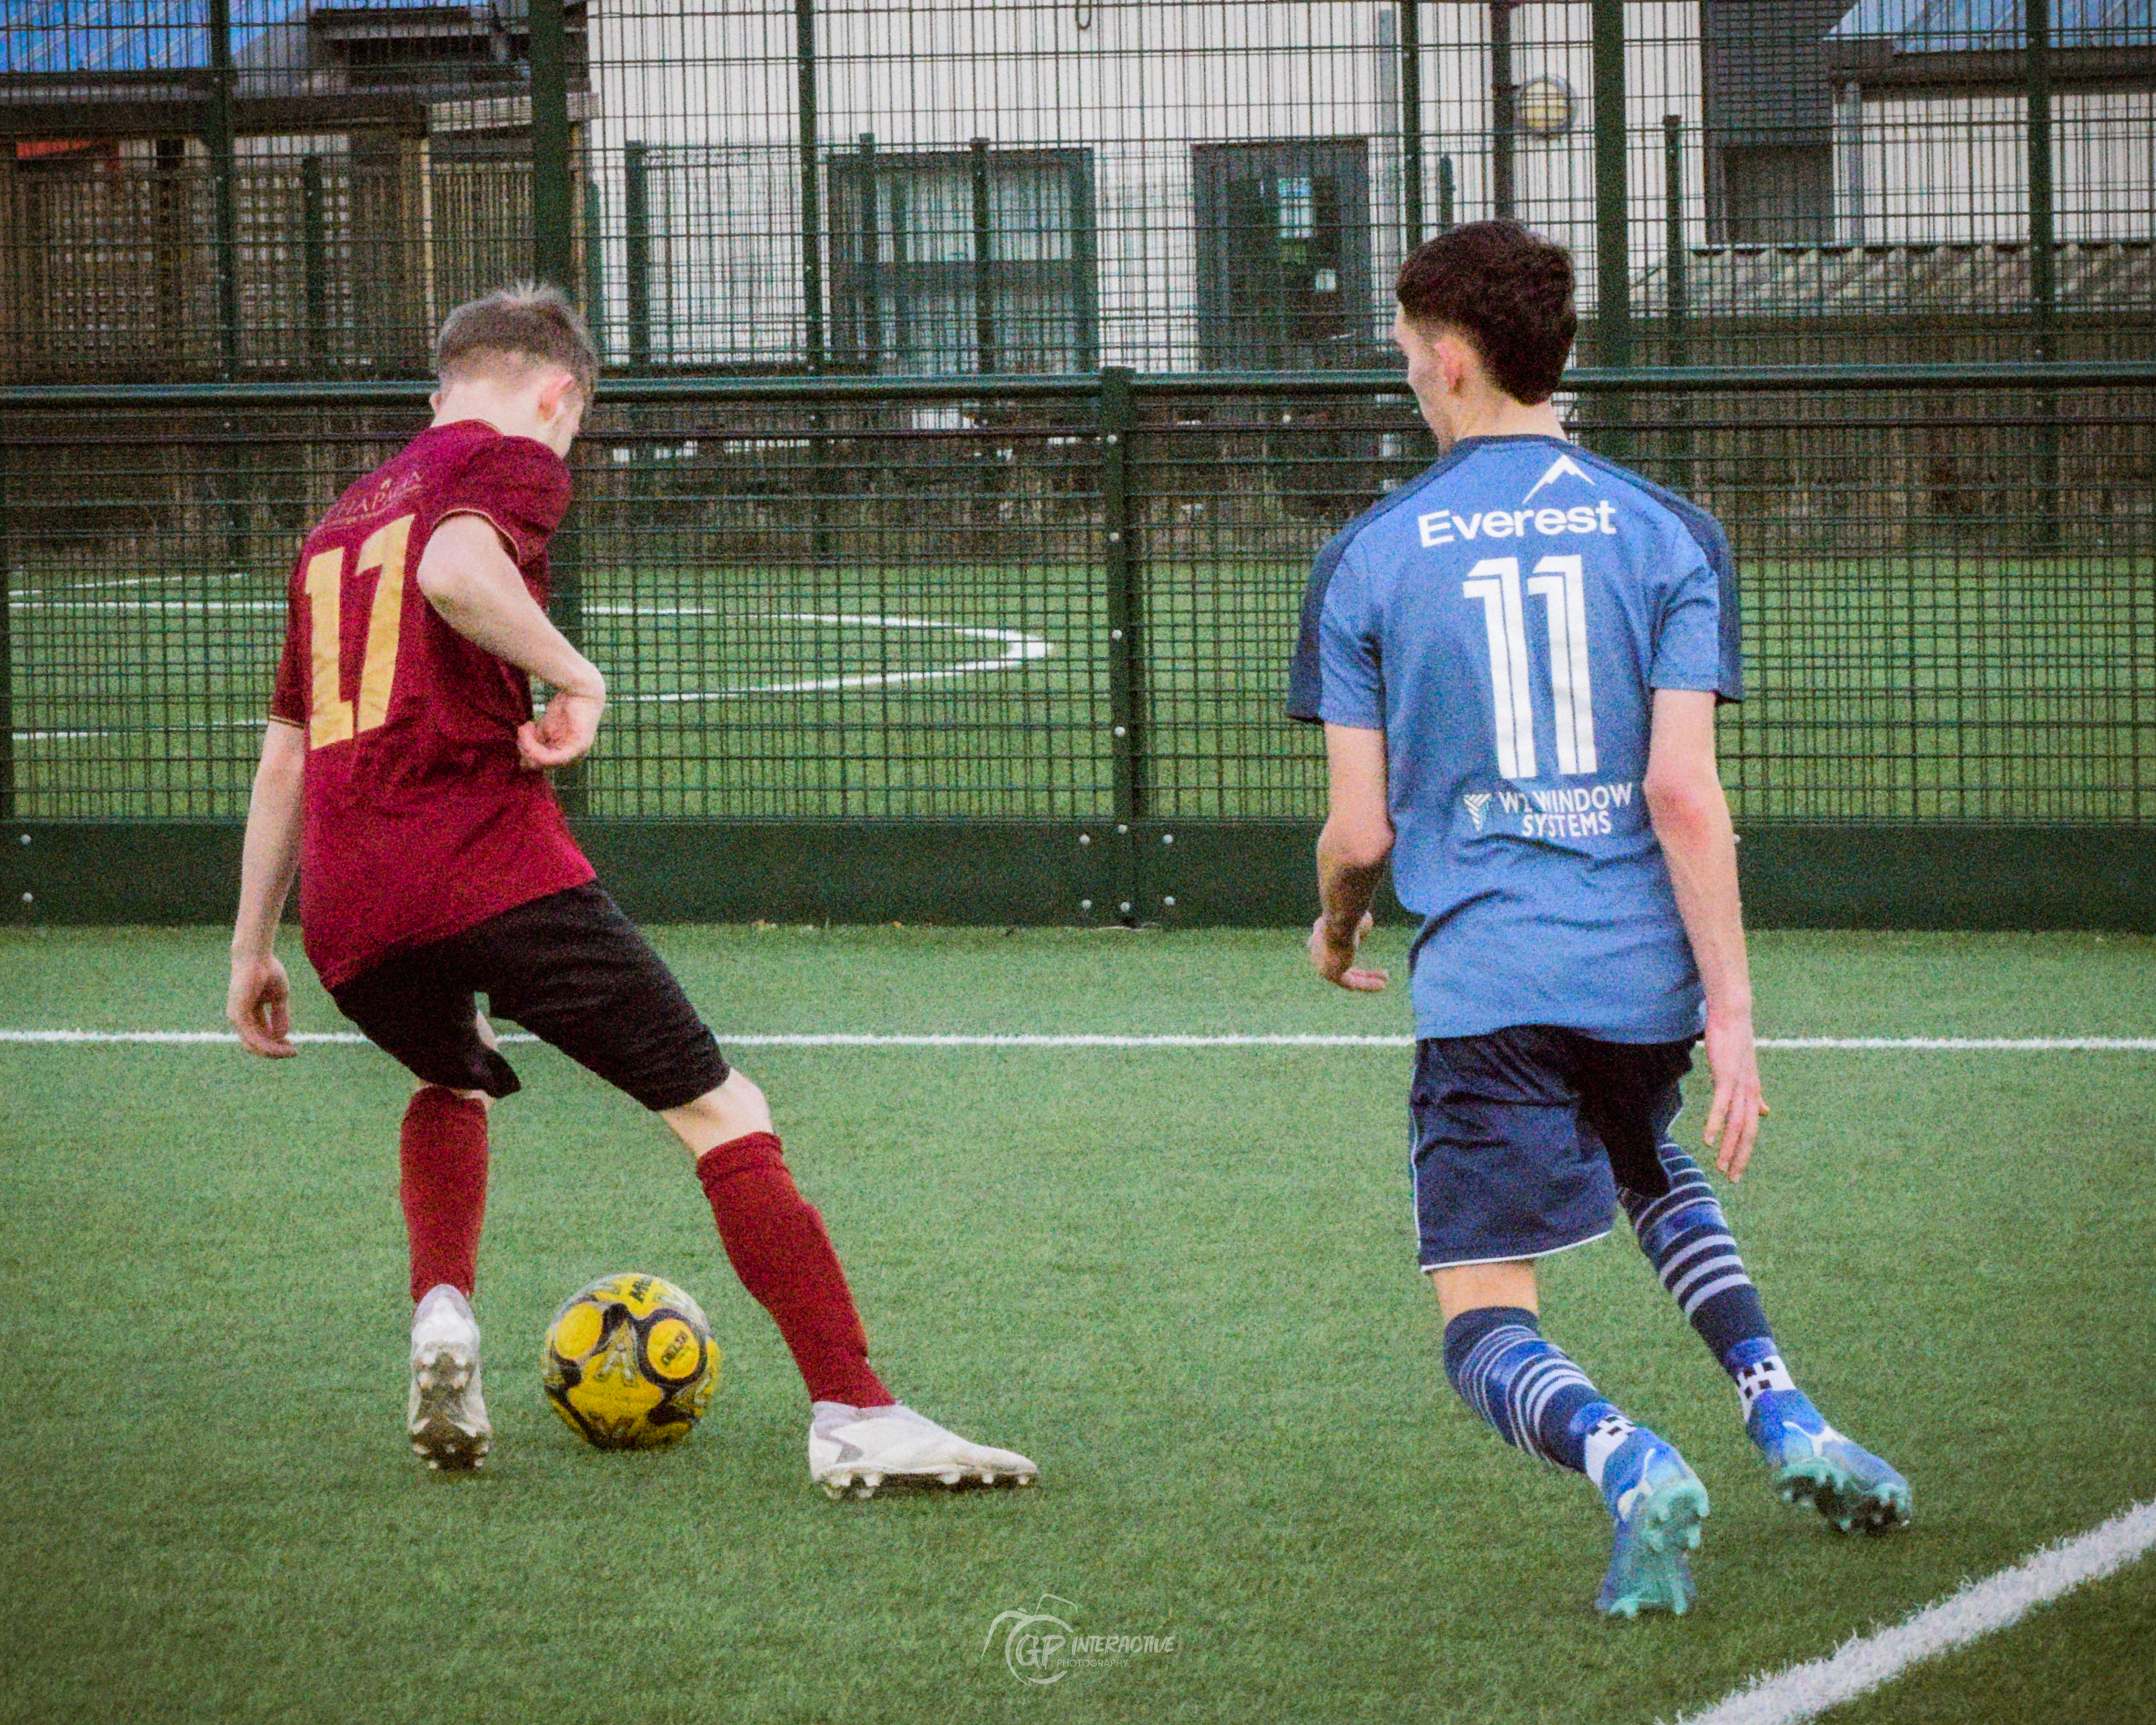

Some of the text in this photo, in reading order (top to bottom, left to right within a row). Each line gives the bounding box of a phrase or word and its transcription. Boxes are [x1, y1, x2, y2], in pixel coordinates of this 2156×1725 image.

[1418, 499, 1617, 548] Everest
[305, 513, 416, 751] 11
[1463, 554, 1598, 780] 11
[1532, 782, 1632, 813] WINDOW
[1521, 810, 1612, 837] SYSTEMS
